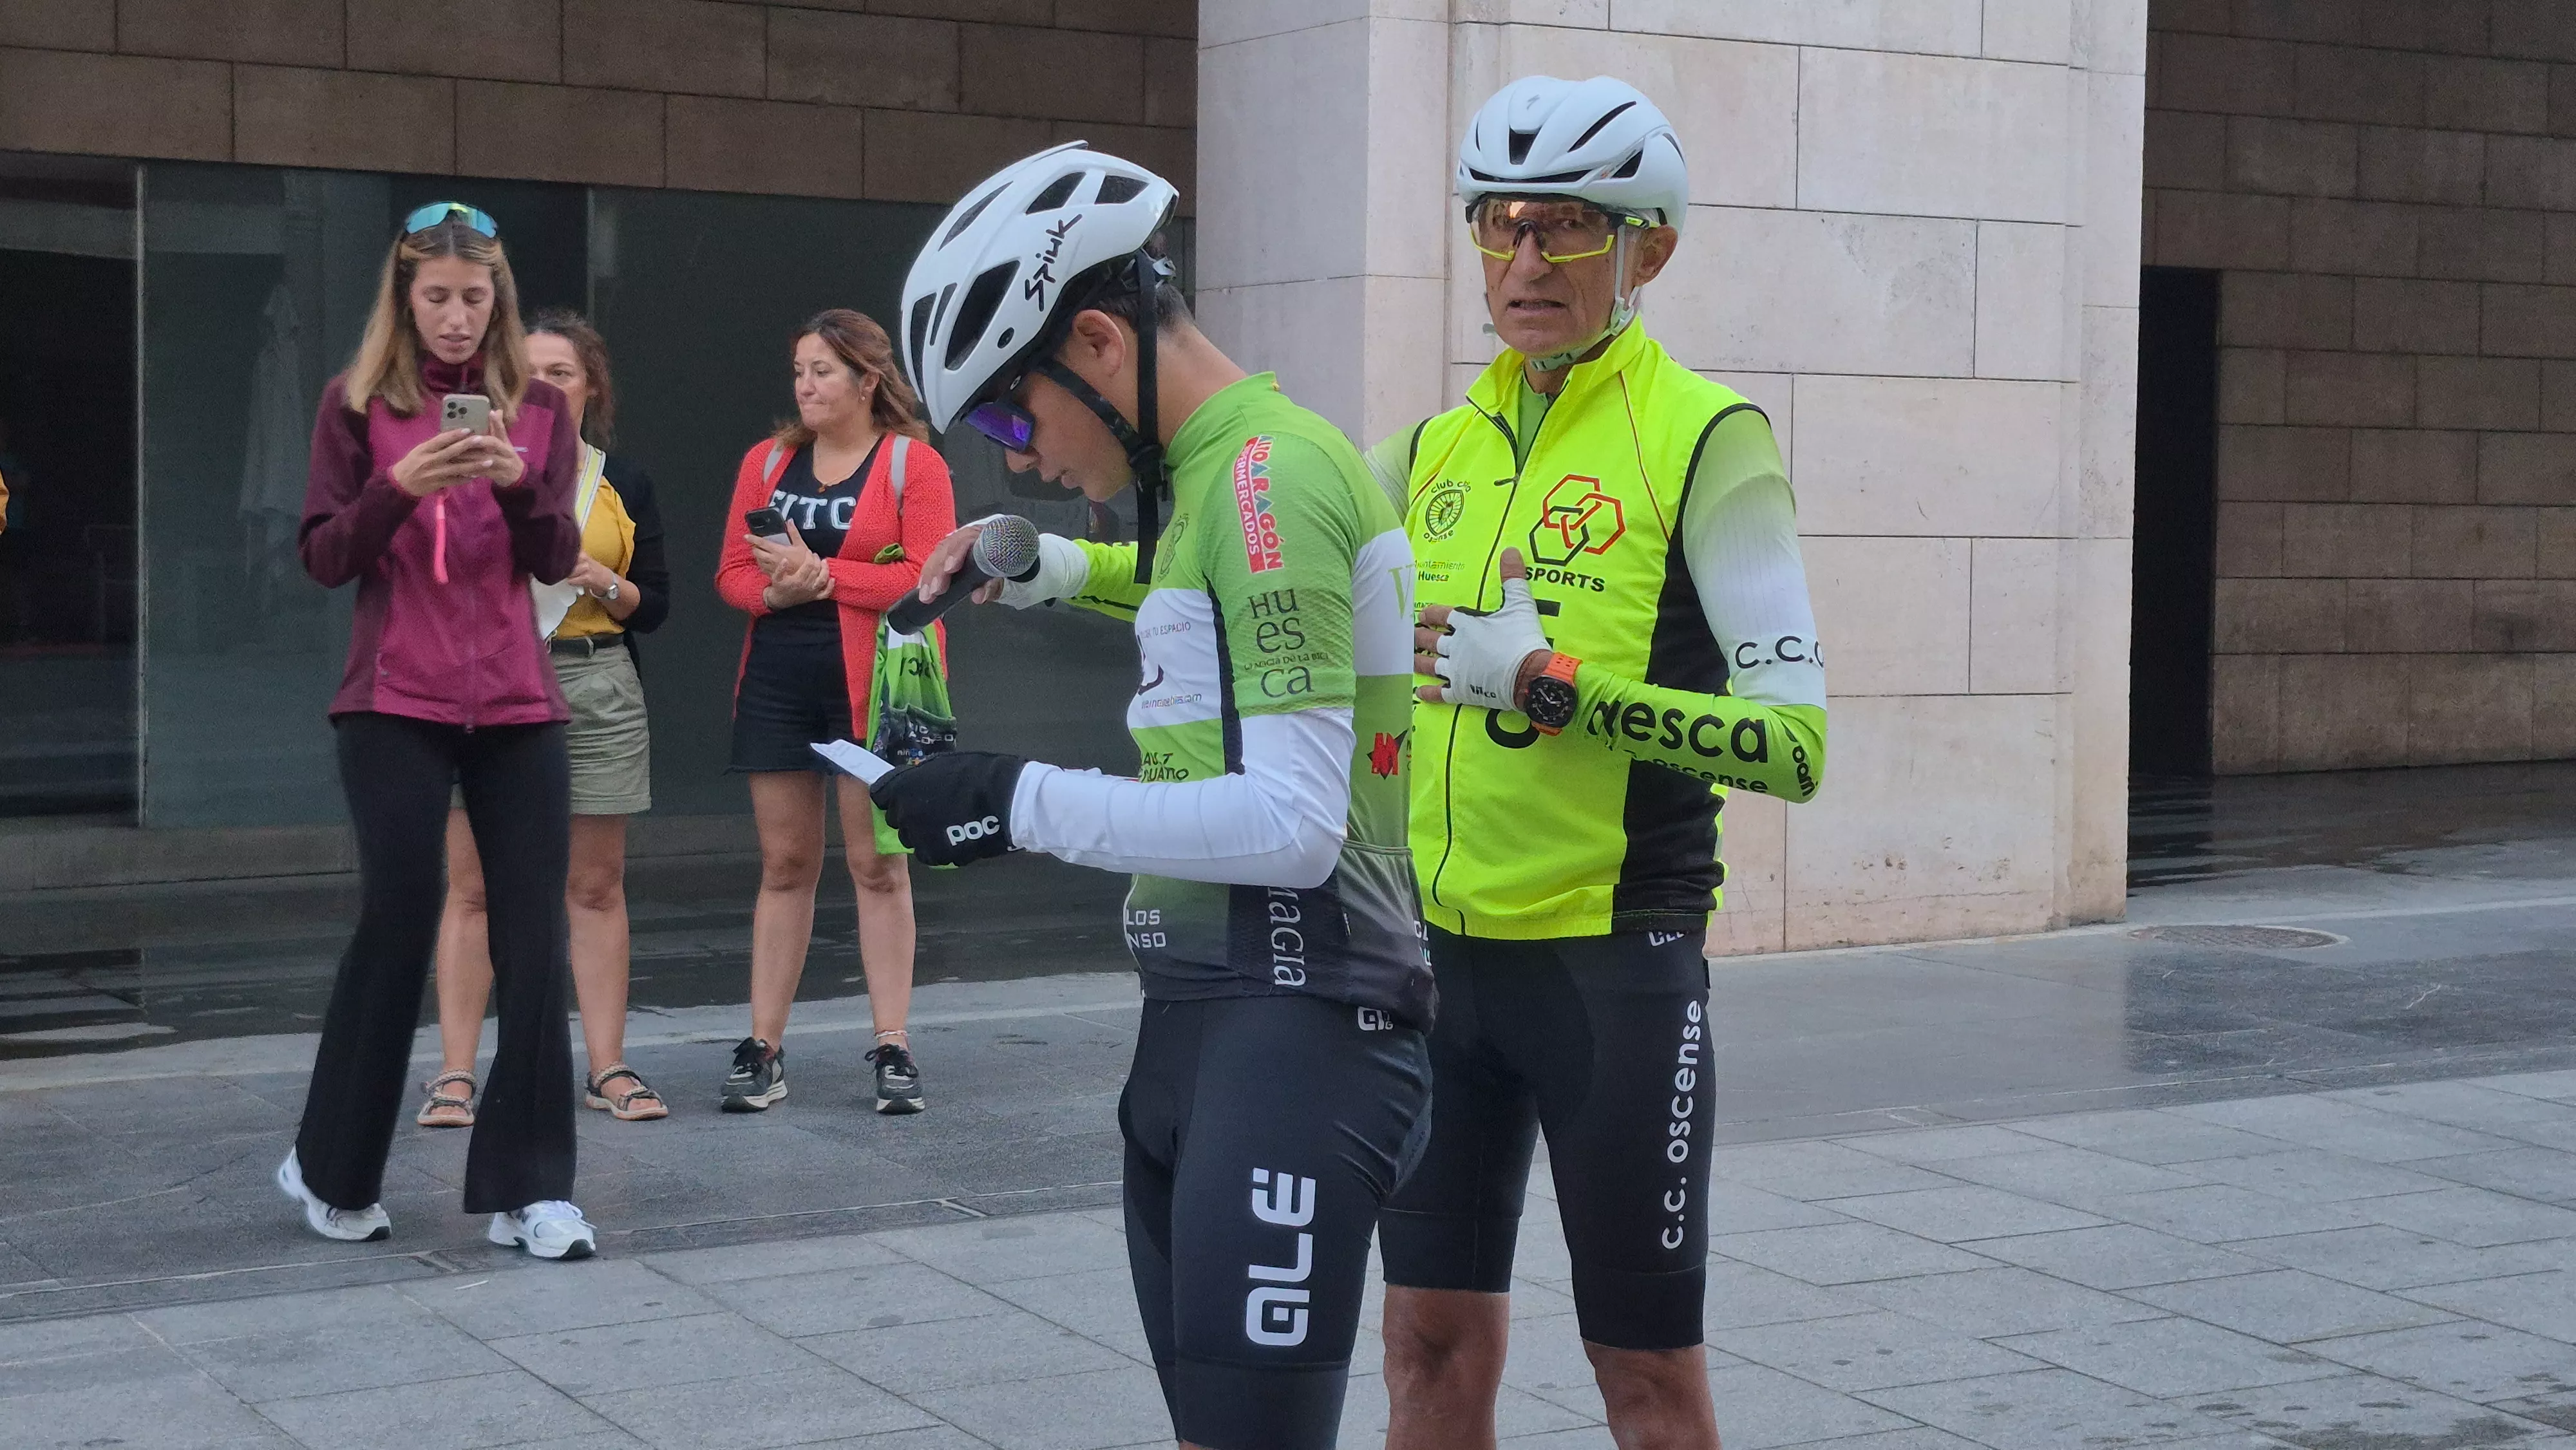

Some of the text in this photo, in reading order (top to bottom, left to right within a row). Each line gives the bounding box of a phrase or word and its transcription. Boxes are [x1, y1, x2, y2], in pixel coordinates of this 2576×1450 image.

[1235, 444, 1260, 556] ERMERCADOS
[1256, 617, 1306, 654] es
[1260, 665, 1315, 699] ca
[946, 815, 1001, 847] POC
[1667, 999, 1702, 1163] oscense
